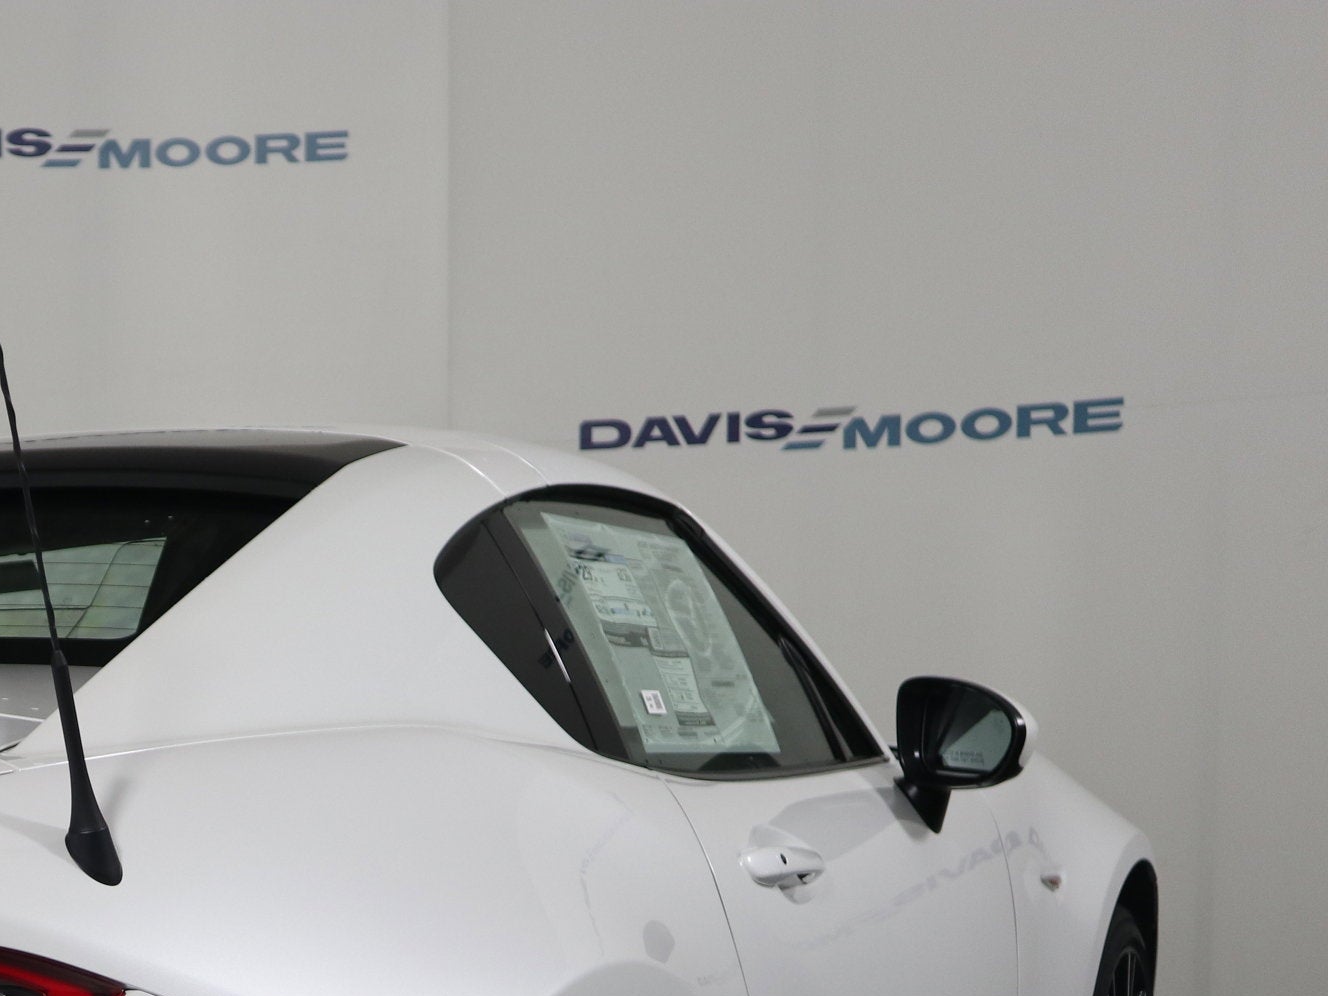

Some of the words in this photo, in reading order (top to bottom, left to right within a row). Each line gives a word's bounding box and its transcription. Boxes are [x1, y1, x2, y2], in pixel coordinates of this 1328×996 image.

[98, 130, 349, 169] MOORE
[579, 408, 794, 451] DAVIS
[843, 397, 1125, 451] MOORE
